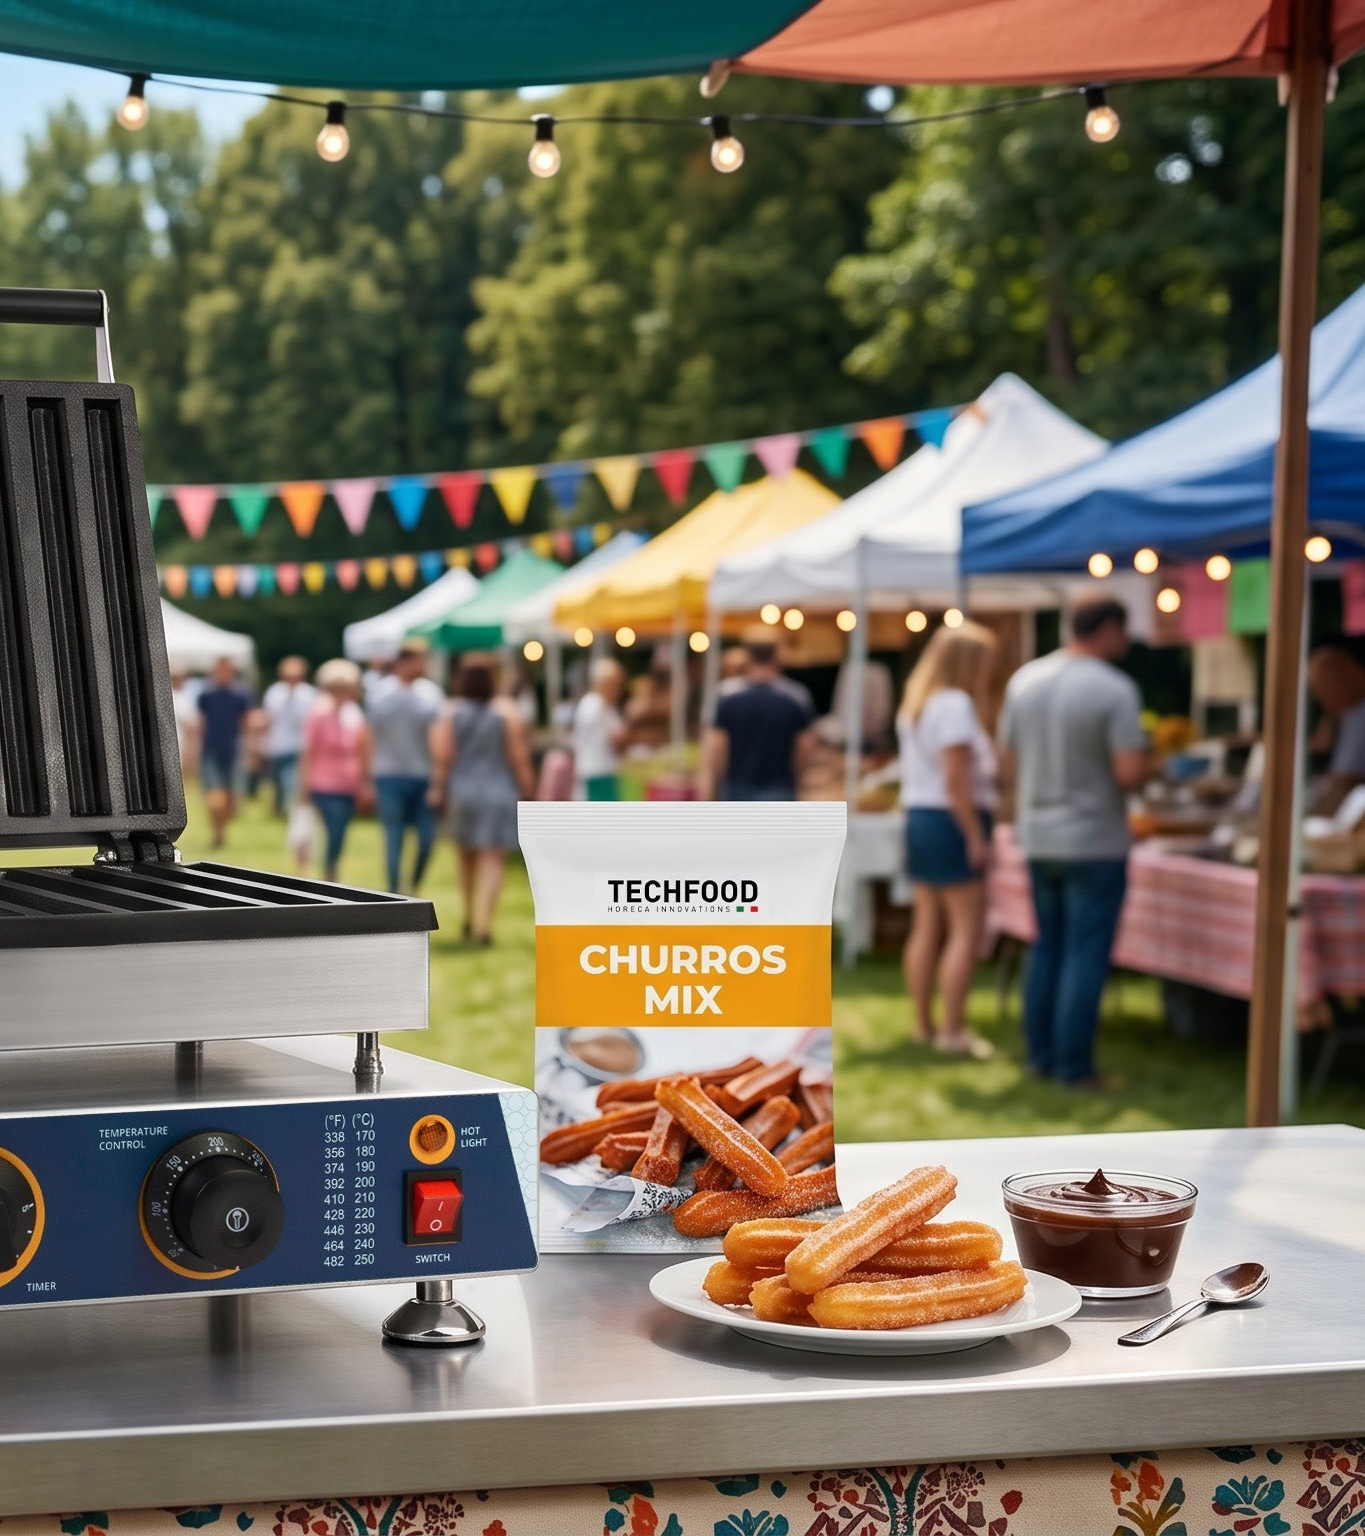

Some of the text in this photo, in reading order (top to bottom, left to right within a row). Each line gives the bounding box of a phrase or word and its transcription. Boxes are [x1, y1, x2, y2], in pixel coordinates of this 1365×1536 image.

[608, 880, 758, 903] TECHFOOD
[607, 905, 731, 913] HORECA INNOVATIONS
[579, 944, 787, 975] CHURROS
[644, 985, 723, 1015] MIX
[324, 1113, 375, 1130] (°F) (°C)
[99, 1126, 169, 1138] TEMPERATURE
[324, 1130, 375, 1143] 338 170
[460, 1126, 481, 1136] HOT
[99, 1140, 146, 1150] CONTROL
[207, 1136, 224, 1147] 200
[460, 1138, 487, 1148] LIGHT
[324, 1145, 375, 1159] 356 180
[166, 1155, 182, 1171] 150
[324, 1161, 375, 1174] 374 190
[324, 1176, 375, 1189] 392 200
[324, 1192, 375, 1204] 410 210
[151, 1201, 162, 1217] 100
[324, 1207, 375, 1220] 428 220
[324, 1223, 375, 1235] 446 230
[324, 1238, 375, 1251] 464 240
[324, 1254, 375, 1267] 482 250
[415, 1253, 450, 1264] SWITCH
[26, 1281, 56, 1292] TIMER
